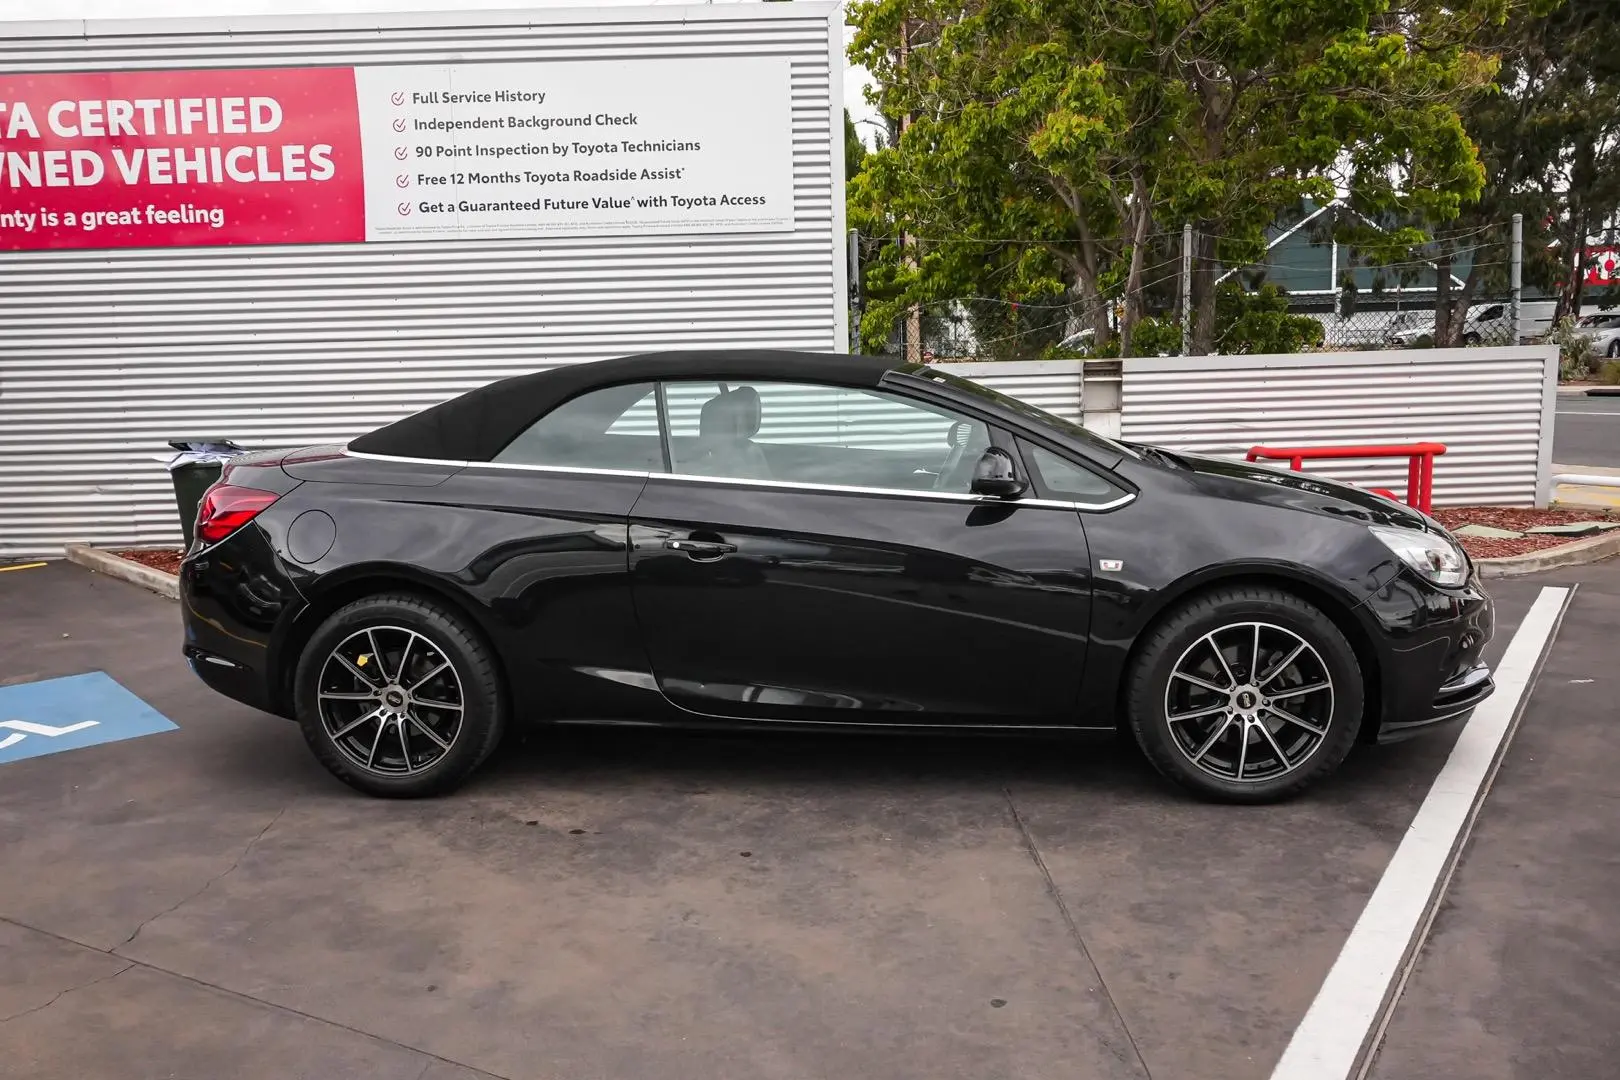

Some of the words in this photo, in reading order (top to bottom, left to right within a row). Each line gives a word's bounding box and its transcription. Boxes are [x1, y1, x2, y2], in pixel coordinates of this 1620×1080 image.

[412, 92, 439, 105] Full
[441, 91, 492, 104] Service
[494, 90, 546, 105] History
[0, 101, 41, 138] A
[48, 96, 283, 138] CERTIFIED
[414, 116, 505, 132] Independent
[507, 115, 593, 131] Background
[595, 112, 638, 127] Check
[415, 146, 433, 158] 90
[436, 144, 473, 158] Point
[475, 143, 549, 159] Inspection
[552, 142, 569, 157] by
[571, 142, 619, 157] Toyota
[620, 140, 701, 153] Technicians
[0, 149, 105, 188] NED
[112, 143, 335, 185] VEHICLES
[417, 173, 447, 186] Free
[450, 173, 465, 185] 12
[468, 171, 521, 184] Months
[523, 171, 570, 186] Toyota
[573, 168, 637, 182] Roadside
[418, 201, 445, 214] Get
[447, 203, 455, 213] a
[458, 198, 541, 213] Guaranteed
[543, 198, 589, 211] Future
[636, 195, 668, 208] with
[670, 195, 717, 210] Toyota
[719, 194, 766, 207] Access
[40, 206, 59, 227] is
[63, 211, 77, 227] a
[81, 207, 142, 231] great
[145, 203, 225, 228] feeling
